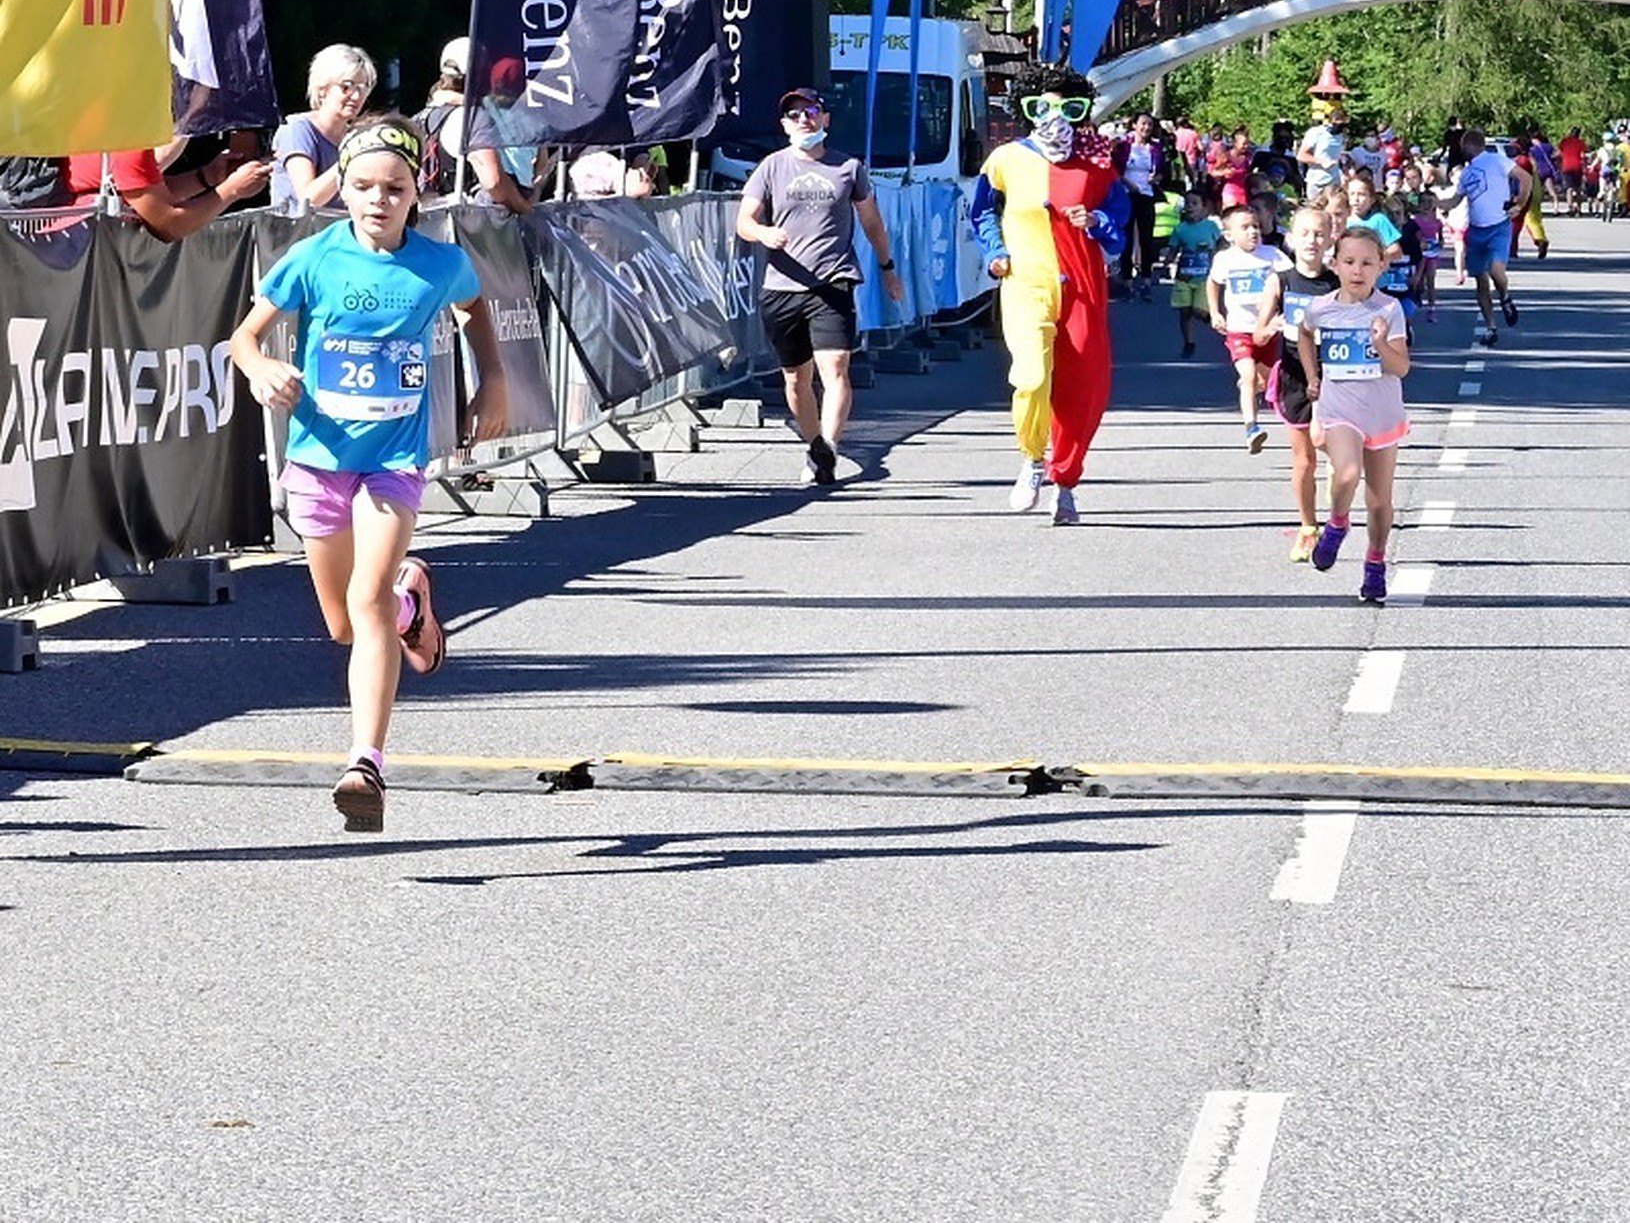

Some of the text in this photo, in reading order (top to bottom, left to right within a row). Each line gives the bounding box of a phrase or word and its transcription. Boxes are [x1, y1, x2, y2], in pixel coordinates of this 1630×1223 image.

[786, 191, 836, 201] MERIDA
[1328, 344, 1350, 360] 60
[338, 360, 376, 389] 26
